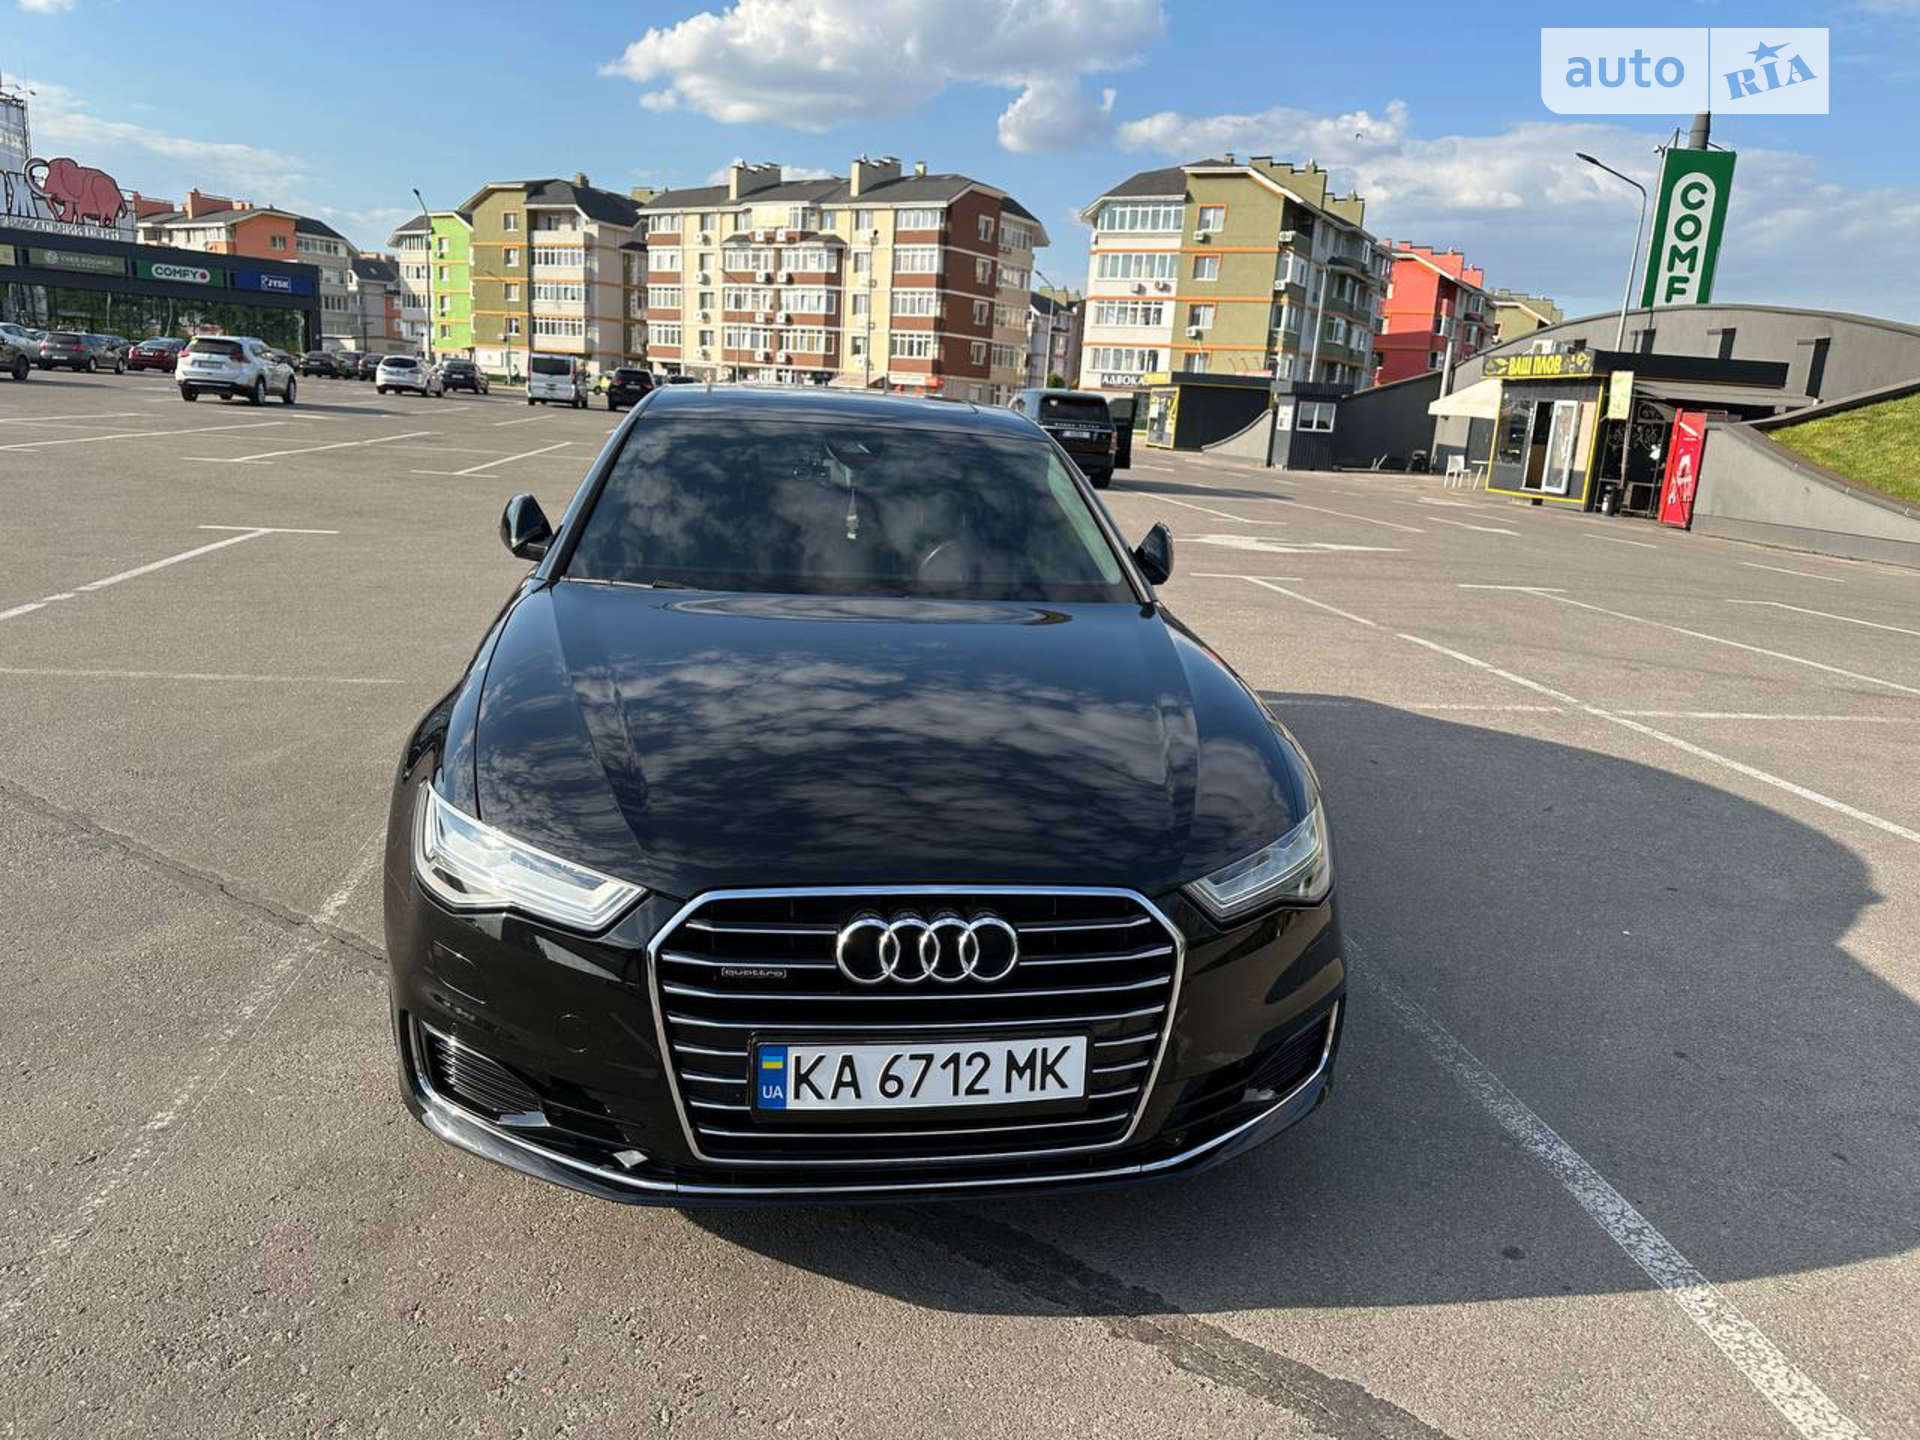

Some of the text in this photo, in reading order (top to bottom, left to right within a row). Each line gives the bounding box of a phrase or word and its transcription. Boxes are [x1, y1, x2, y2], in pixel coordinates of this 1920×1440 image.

[154, 266, 199, 280] COMFY
[267, 279, 290, 290] JYSK
[793, 1045, 1071, 1100] KA 6712 MK
[762, 1087, 783, 1099] UA
